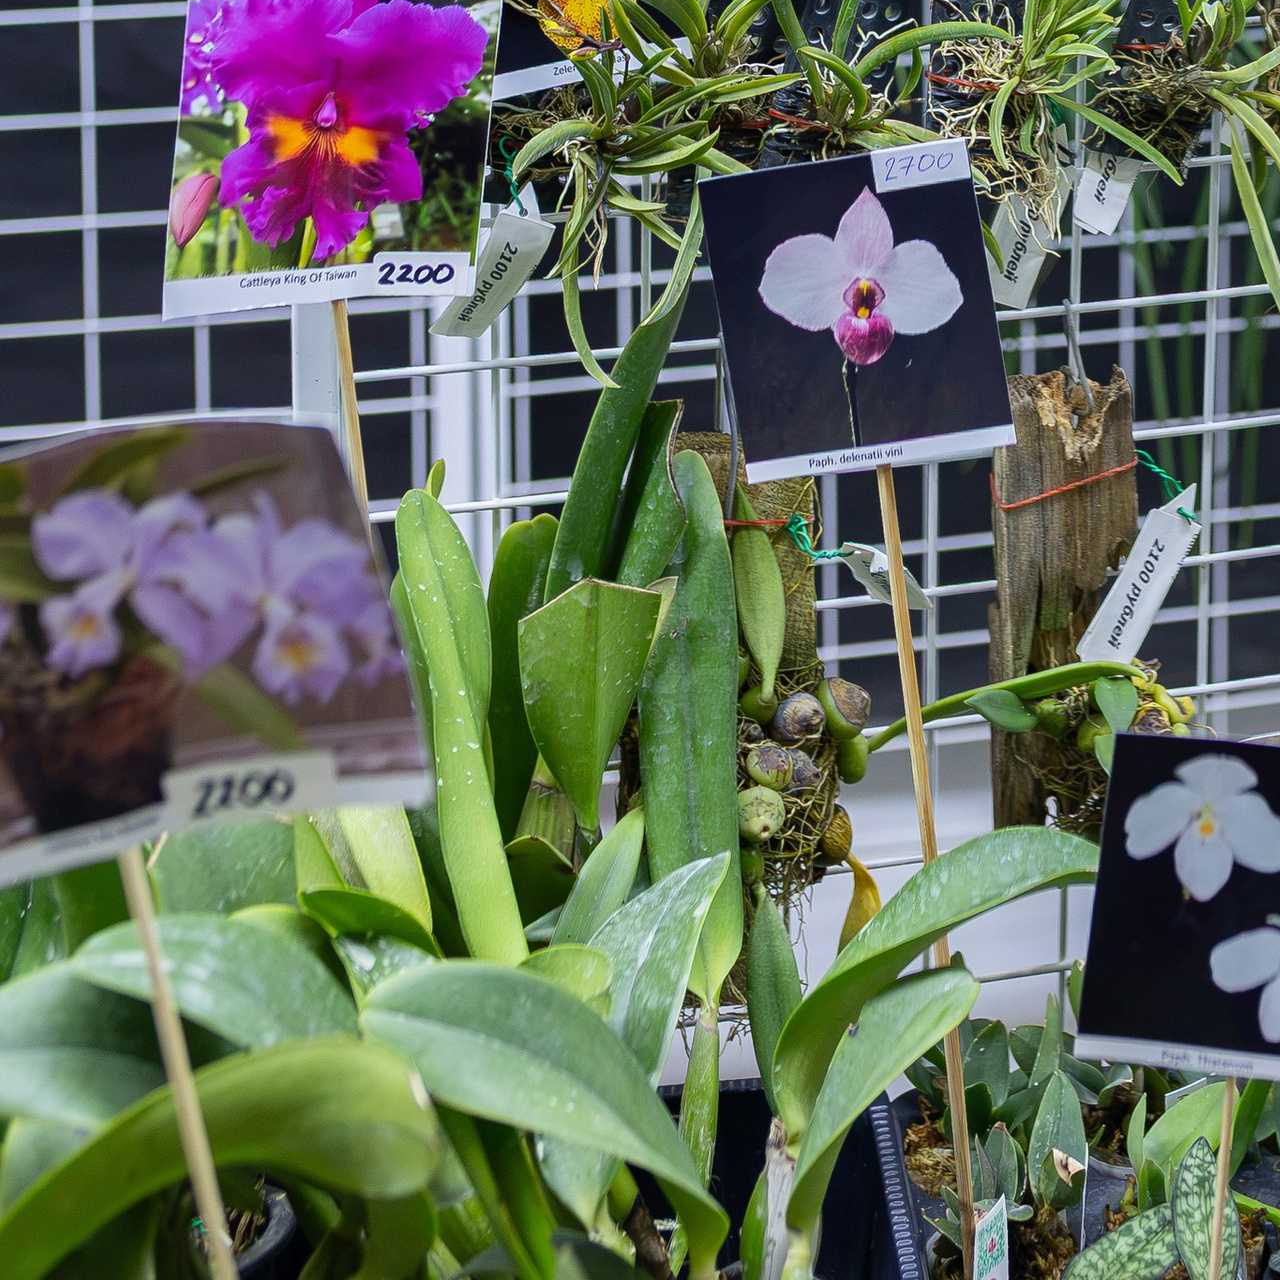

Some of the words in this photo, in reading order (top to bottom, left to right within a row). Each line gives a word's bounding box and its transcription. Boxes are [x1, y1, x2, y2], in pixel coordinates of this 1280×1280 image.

[884, 152, 954, 182] 2700
[1093, 155, 1117, 204] блей
[240, 273, 281, 289] Cattleya
[283, 272, 307, 287] King
[309, 271, 323, 283] Of
[325, 269, 357, 281] Taiwan
[377, 261, 455, 286] 2200
[490, 241, 518, 281] 2100
[457, 280, 494, 322] рублей
[839, 450, 883, 464] delenatii
[884, 446, 904, 458] vini
[1139, 538, 1165, 585] 2100
[1107, 582, 1141, 649] рублей
